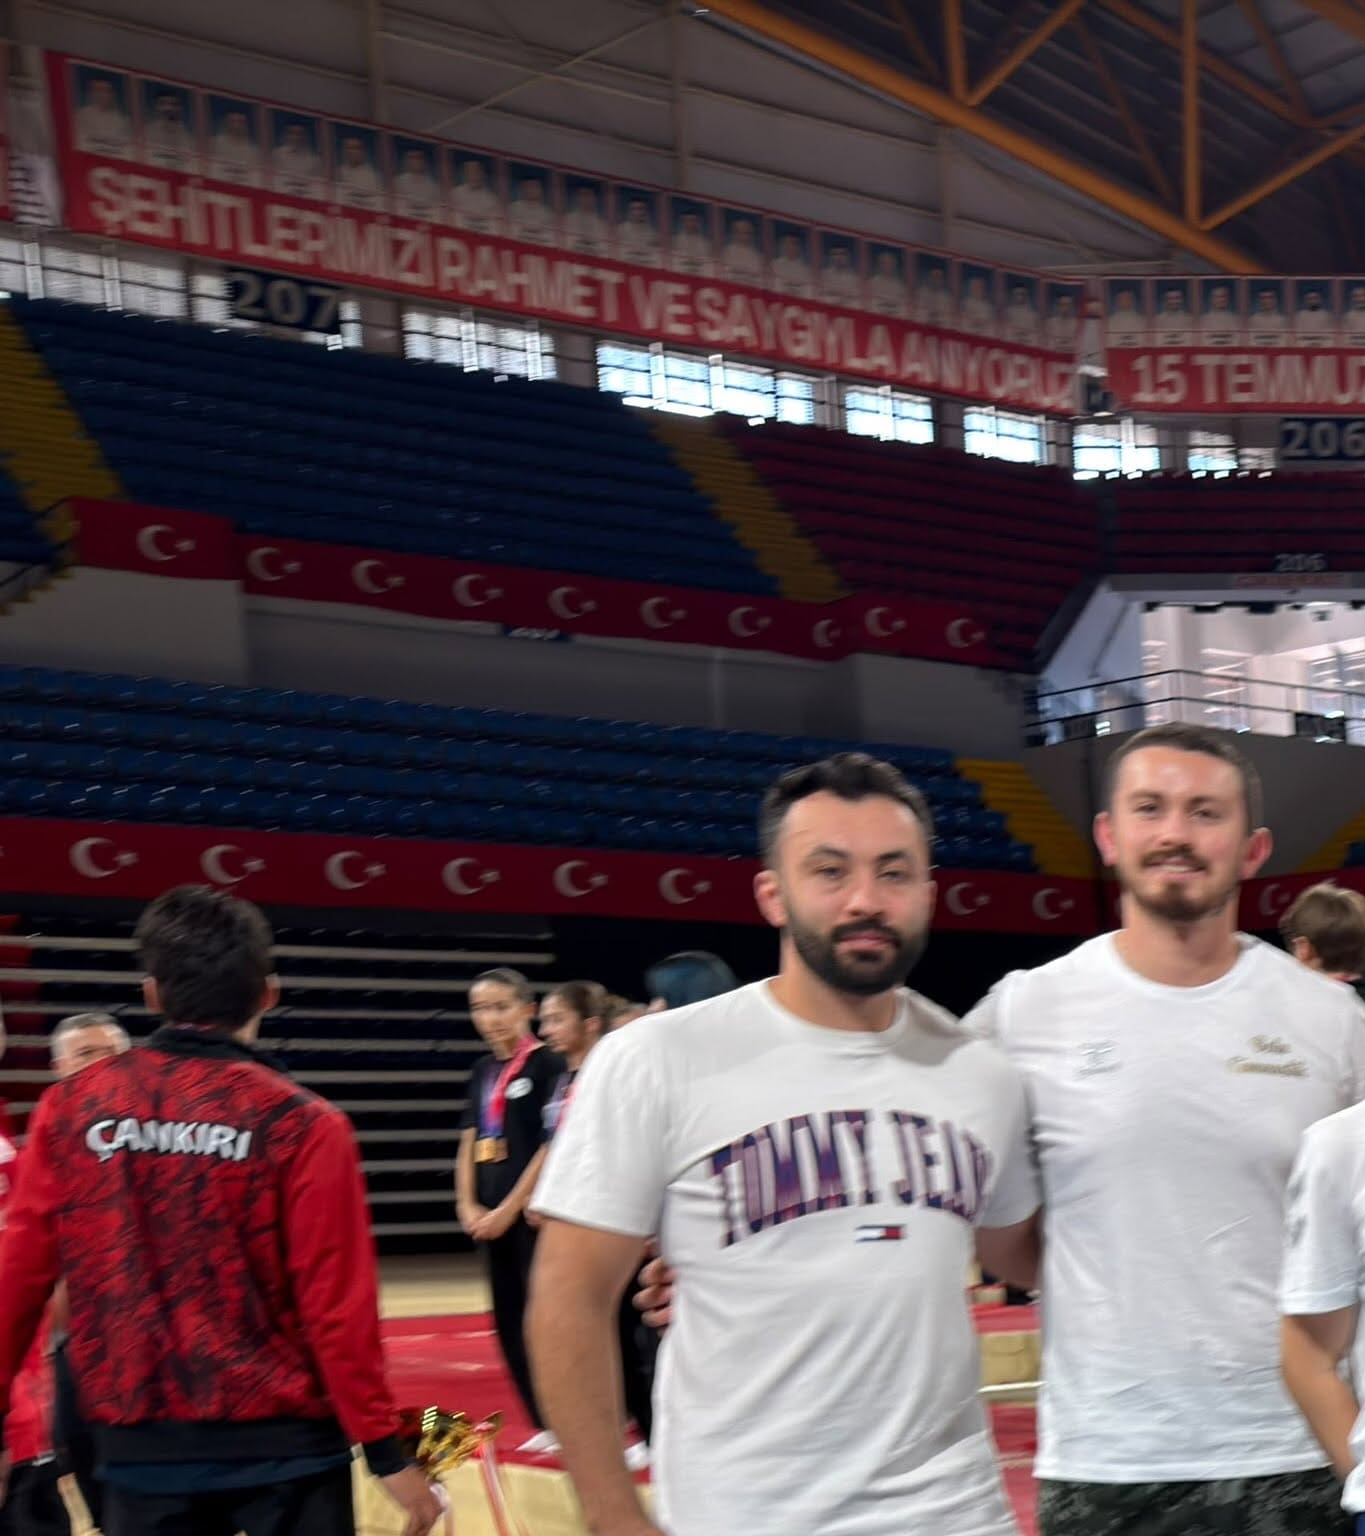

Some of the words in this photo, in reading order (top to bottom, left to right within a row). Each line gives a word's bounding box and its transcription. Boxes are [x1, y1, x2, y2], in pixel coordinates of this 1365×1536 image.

[233, 271, 338, 329] 207
[437, 237, 625, 323] RAHMET
[629, 275, 695, 337] VE
[696, 287, 897, 377] SAYGIYLA
[1130, 353, 1187, 402] 15
[708, 1109, 882, 1248] TOMMY
